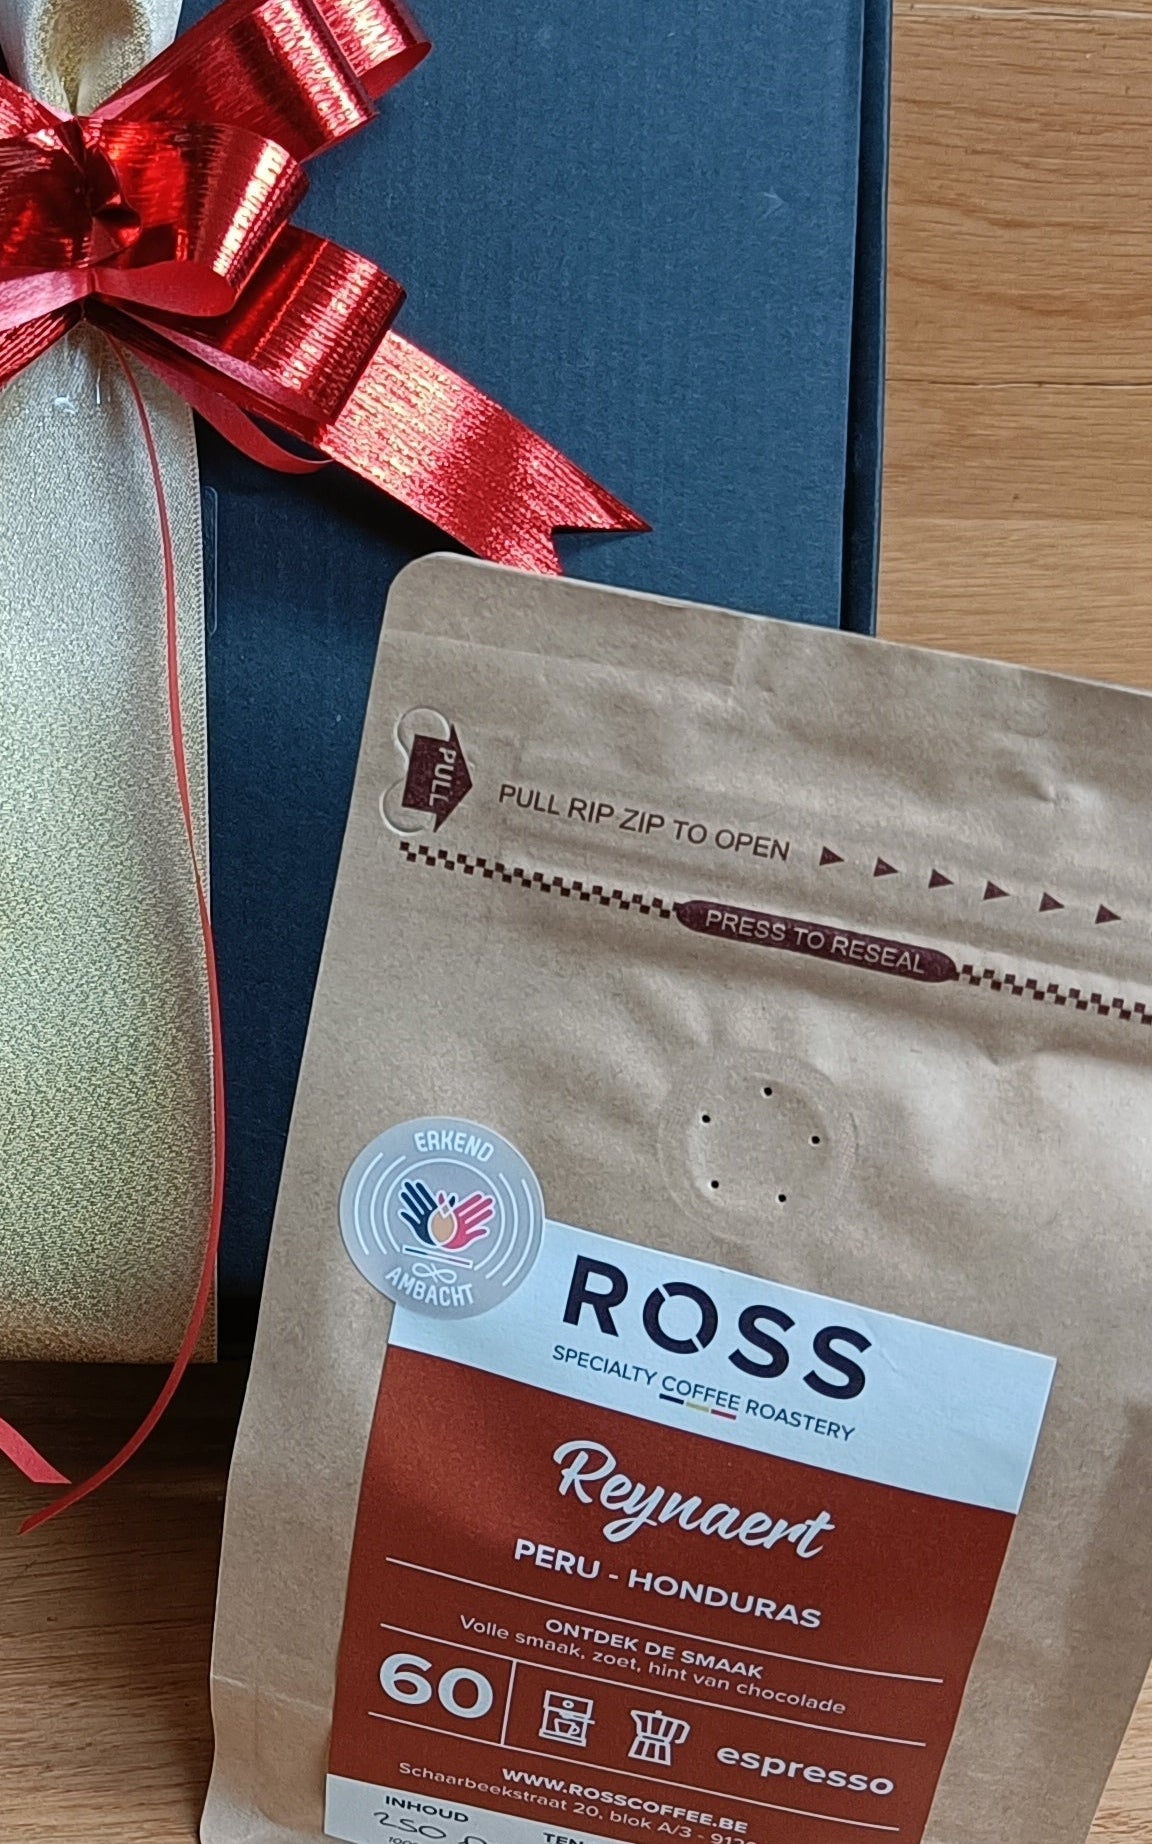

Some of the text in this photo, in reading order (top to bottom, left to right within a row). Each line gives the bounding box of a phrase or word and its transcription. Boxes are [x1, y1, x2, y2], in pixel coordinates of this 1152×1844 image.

[429, 747, 456, 806] PULL
[499, 783, 791, 861] PULL RIP ZIP TO OPEN
[706, 909, 925, 974] PRESS TO RESEAL
[414, 1130, 494, 1162] ERKEND
[385, 1266, 474, 1307] AMBACHT
[562, 1254, 872, 1400] ROSS
[552, 1344, 856, 1442] SPECIALTY COFFEE ROASTERY
[552, 1439, 836, 1559] Reynaert
[514, 1538, 600, 1580] PERU
[628, 1568, 822, 1629] HONDURAS
[459, 1614, 846, 1715] Volle smaak, zoet, hint van chocolade
[544, 1617, 764, 1680] ONTDEK DE SMAAK
[378, 1651, 494, 1720] 60
[399, 1762, 567, 1810] Schaarbeekstraat
[610, 1811, 651, 1830] blok
[657, 1822, 692, 1839] A/3
[502, 1768, 748, 1834] WWW.ROSSCOFFEE.BE
[716, 1743, 894, 1797] espresso
[373, 1812, 447, 1839] 250
[385, 1795, 469, 1823] INHOUD
